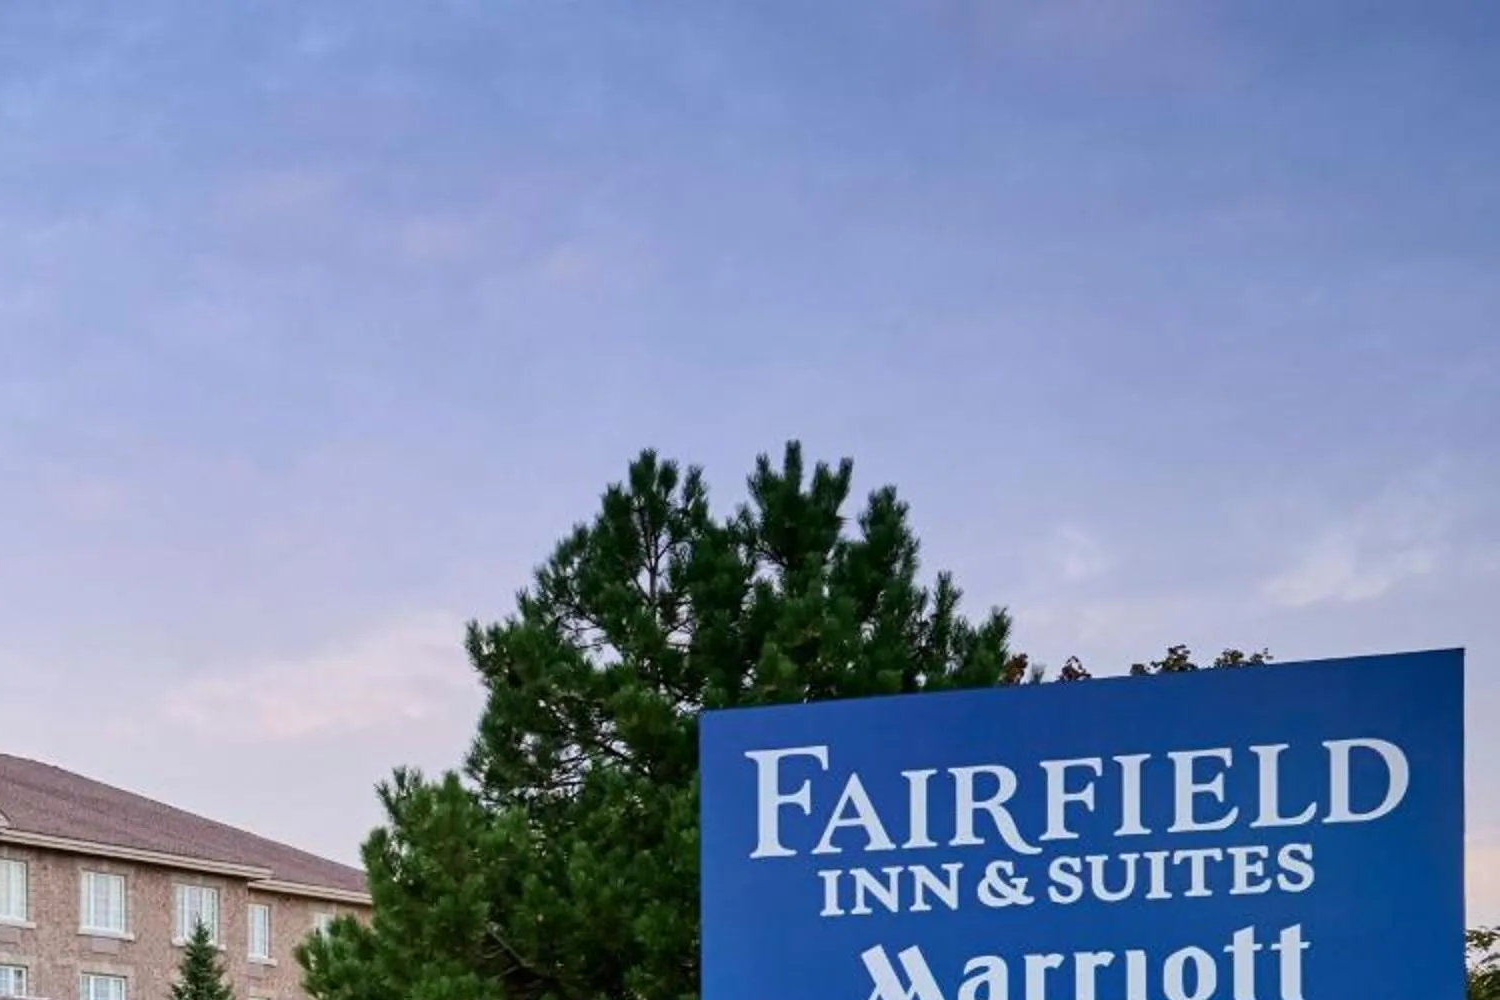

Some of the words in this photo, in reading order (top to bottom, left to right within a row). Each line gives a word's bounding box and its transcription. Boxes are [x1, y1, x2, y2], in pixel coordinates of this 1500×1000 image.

[744, 738, 1410, 859] FAIRFIELD
[818, 862, 964, 917] INN
[977, 860, 1035, 907] &
[1047, 843, 1315, 904] SUITES
